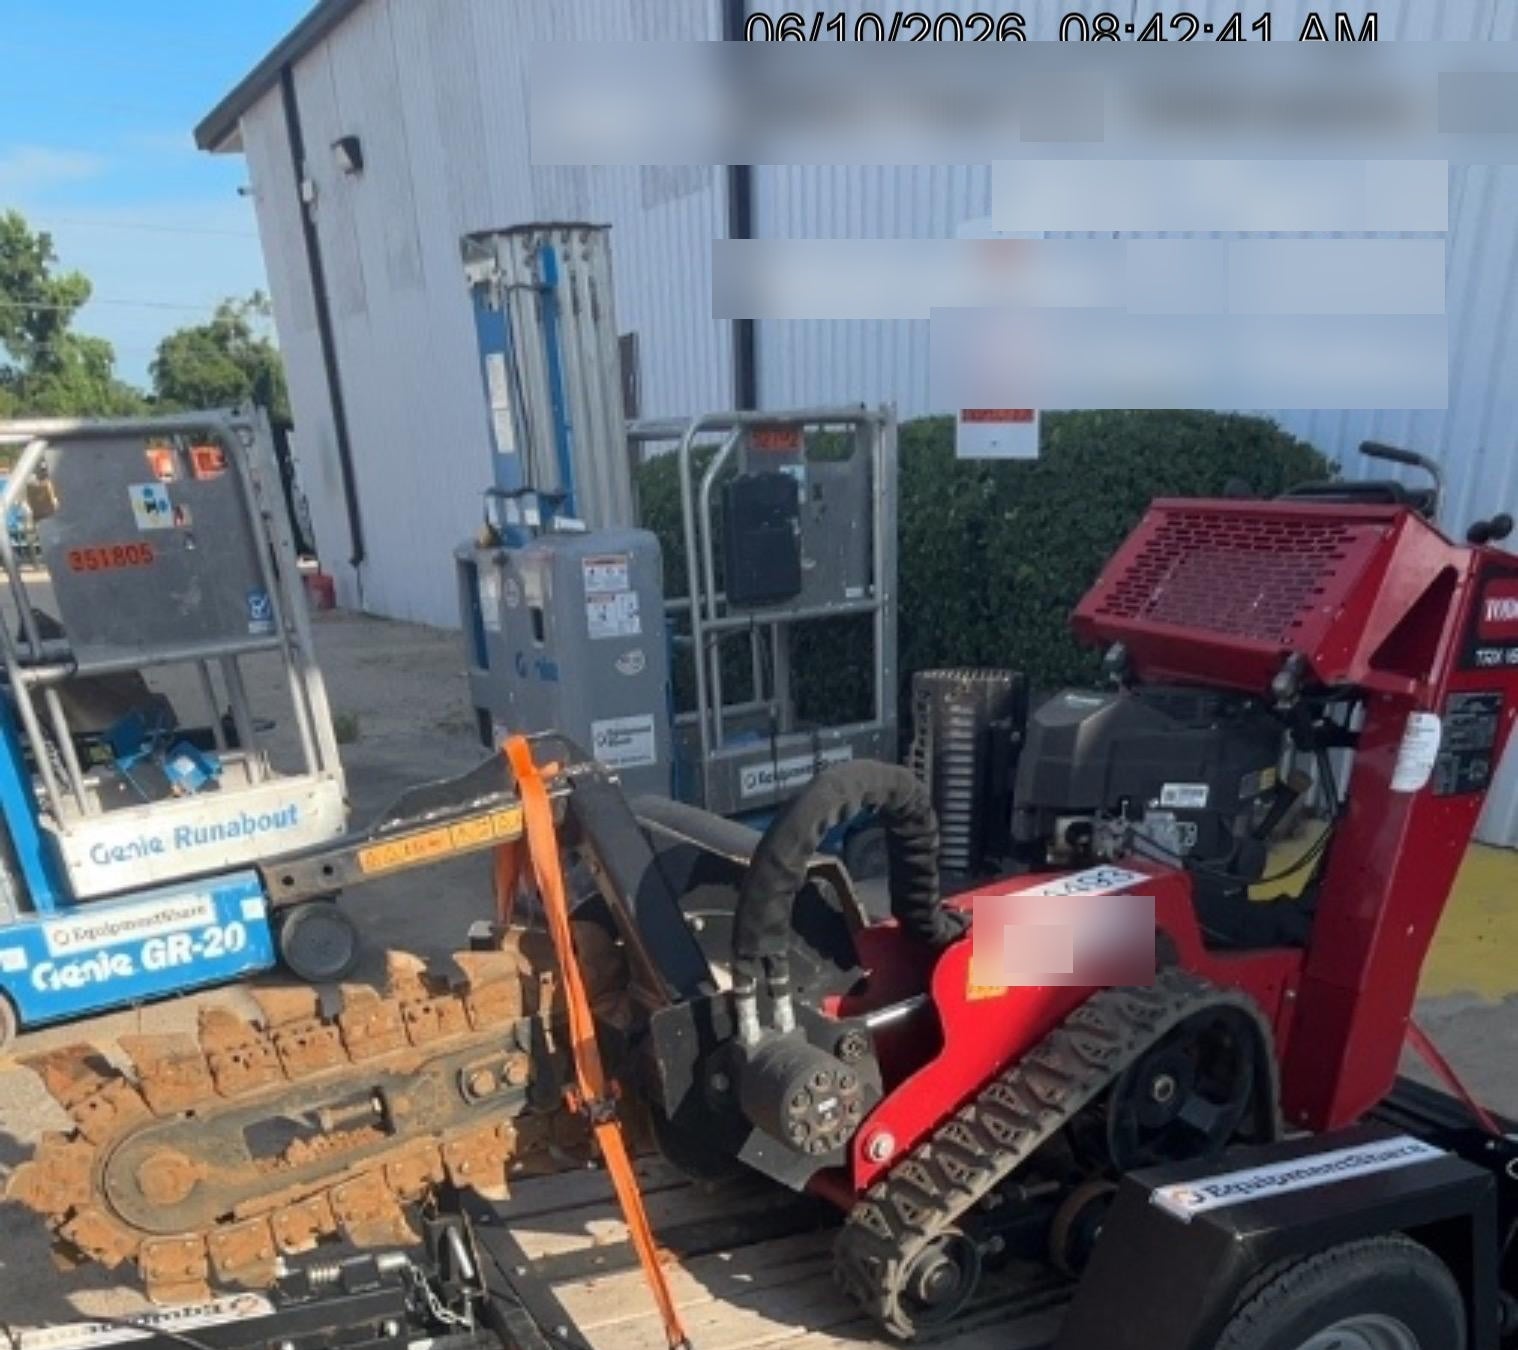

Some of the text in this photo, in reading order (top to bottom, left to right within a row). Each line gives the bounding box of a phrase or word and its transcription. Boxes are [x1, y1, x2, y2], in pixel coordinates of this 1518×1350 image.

[90, 804, 298, 864] Genie Runabout
[31, 921, 246, 991] Genie GR-20
